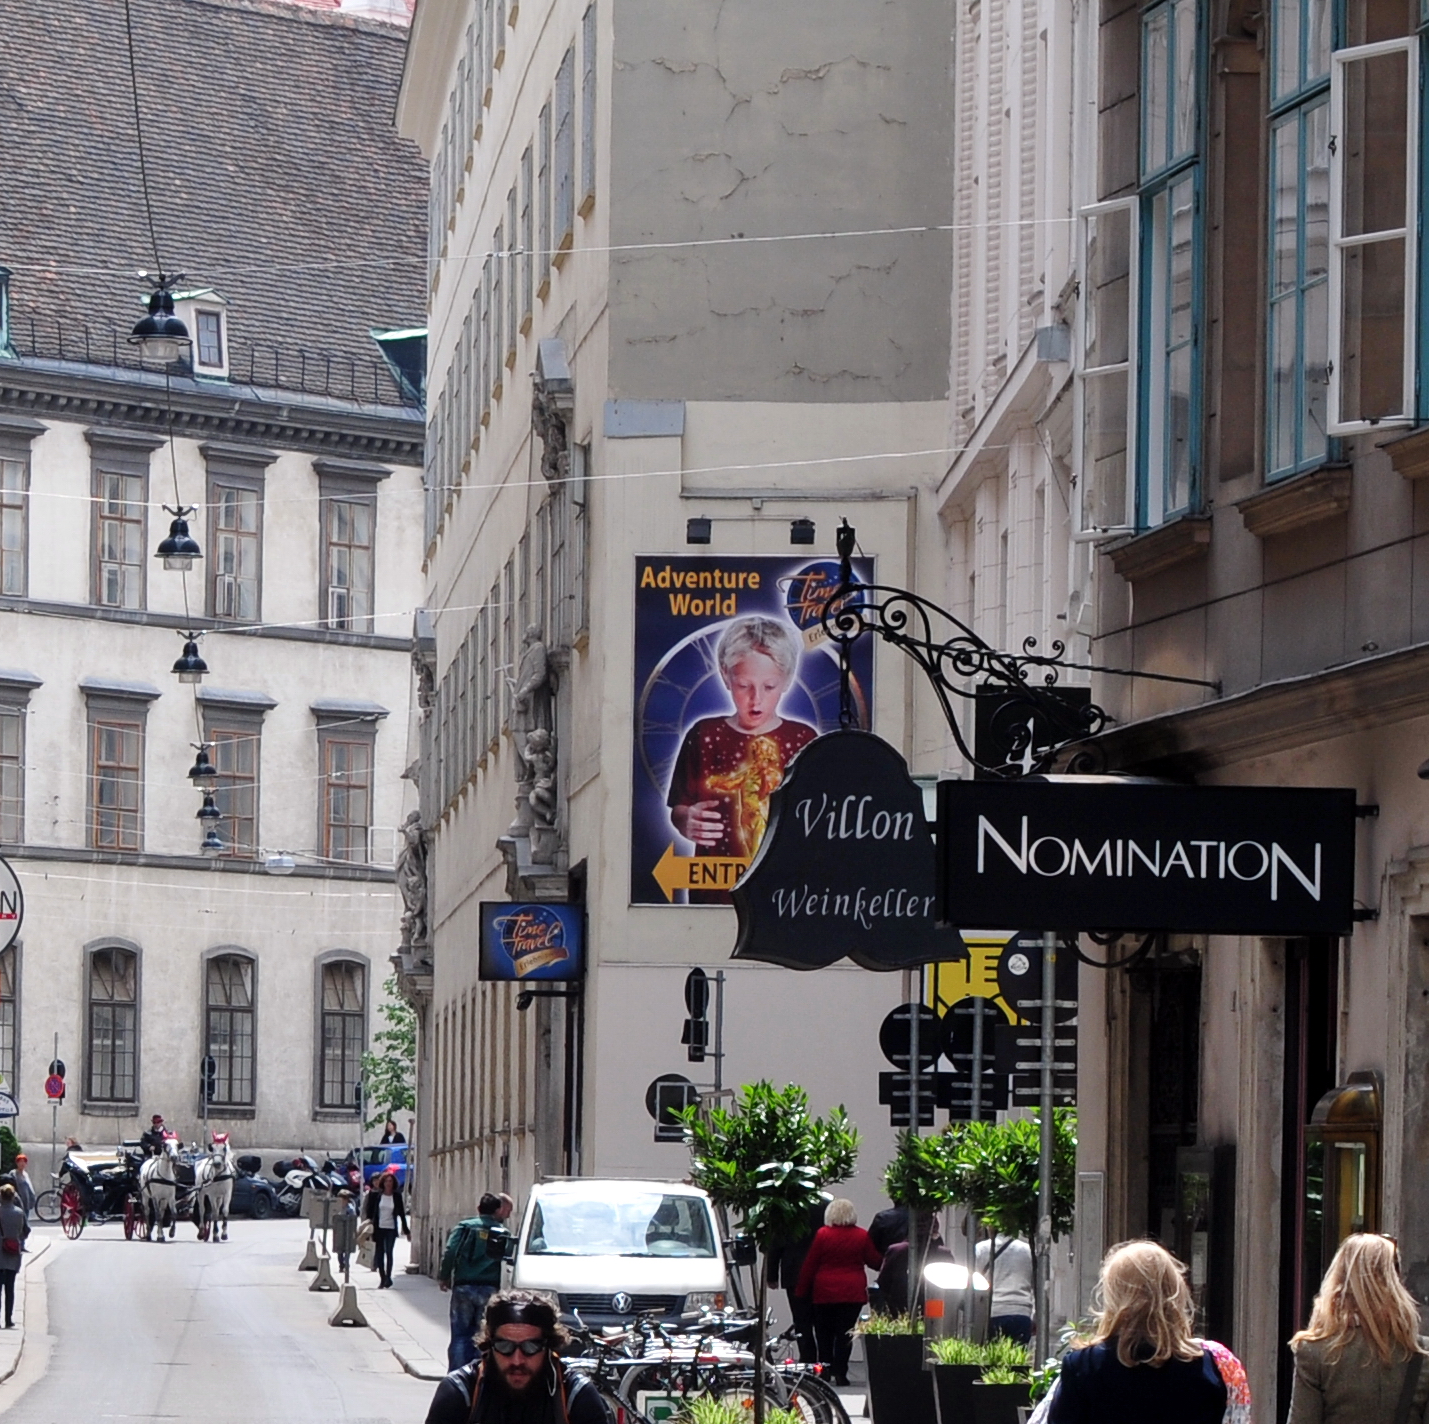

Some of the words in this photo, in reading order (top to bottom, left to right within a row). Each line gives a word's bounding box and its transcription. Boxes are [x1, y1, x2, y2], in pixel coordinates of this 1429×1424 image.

[641, 565, 761, 589] Adventure
[669, 593, 737, 617] World
[795, 792, 914, 841] Villon
[977, 814, 1322, 901] NOMINATION
[772, 884, 935, 930] Weinkeller
